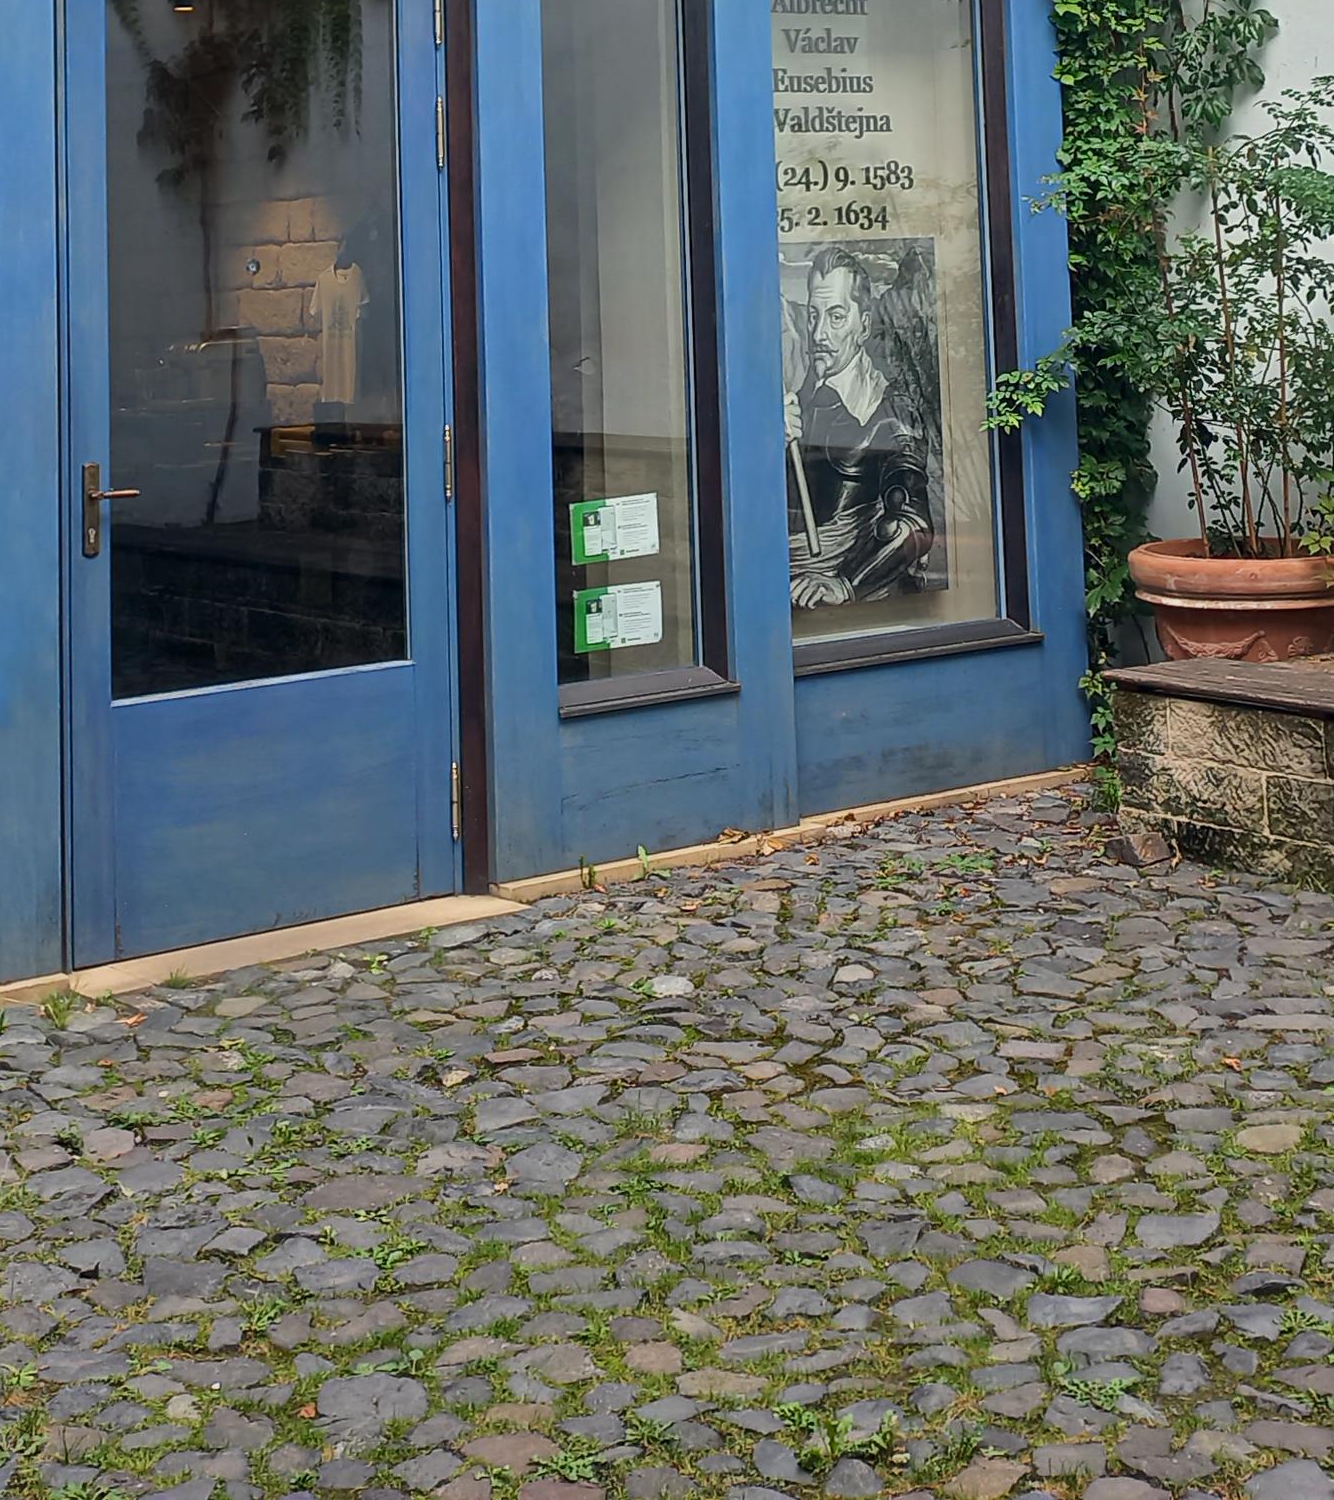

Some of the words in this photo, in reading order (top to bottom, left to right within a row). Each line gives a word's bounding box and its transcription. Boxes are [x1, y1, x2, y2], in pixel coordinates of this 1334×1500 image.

[781, 27, 860, 54] Václav
[772, 67, 874, 94] Eusebius
[773, 106, 893, 139] Valdštejna
[775, 160, 828, 192] (24.)
[834, 166, 856, 192] 9.
[860, 160, 914, 191] 1583
[776, 208, 800, 233] 5.
[807, 206, 828, 226] 2.
[832, 200, 890, 231] 1634
